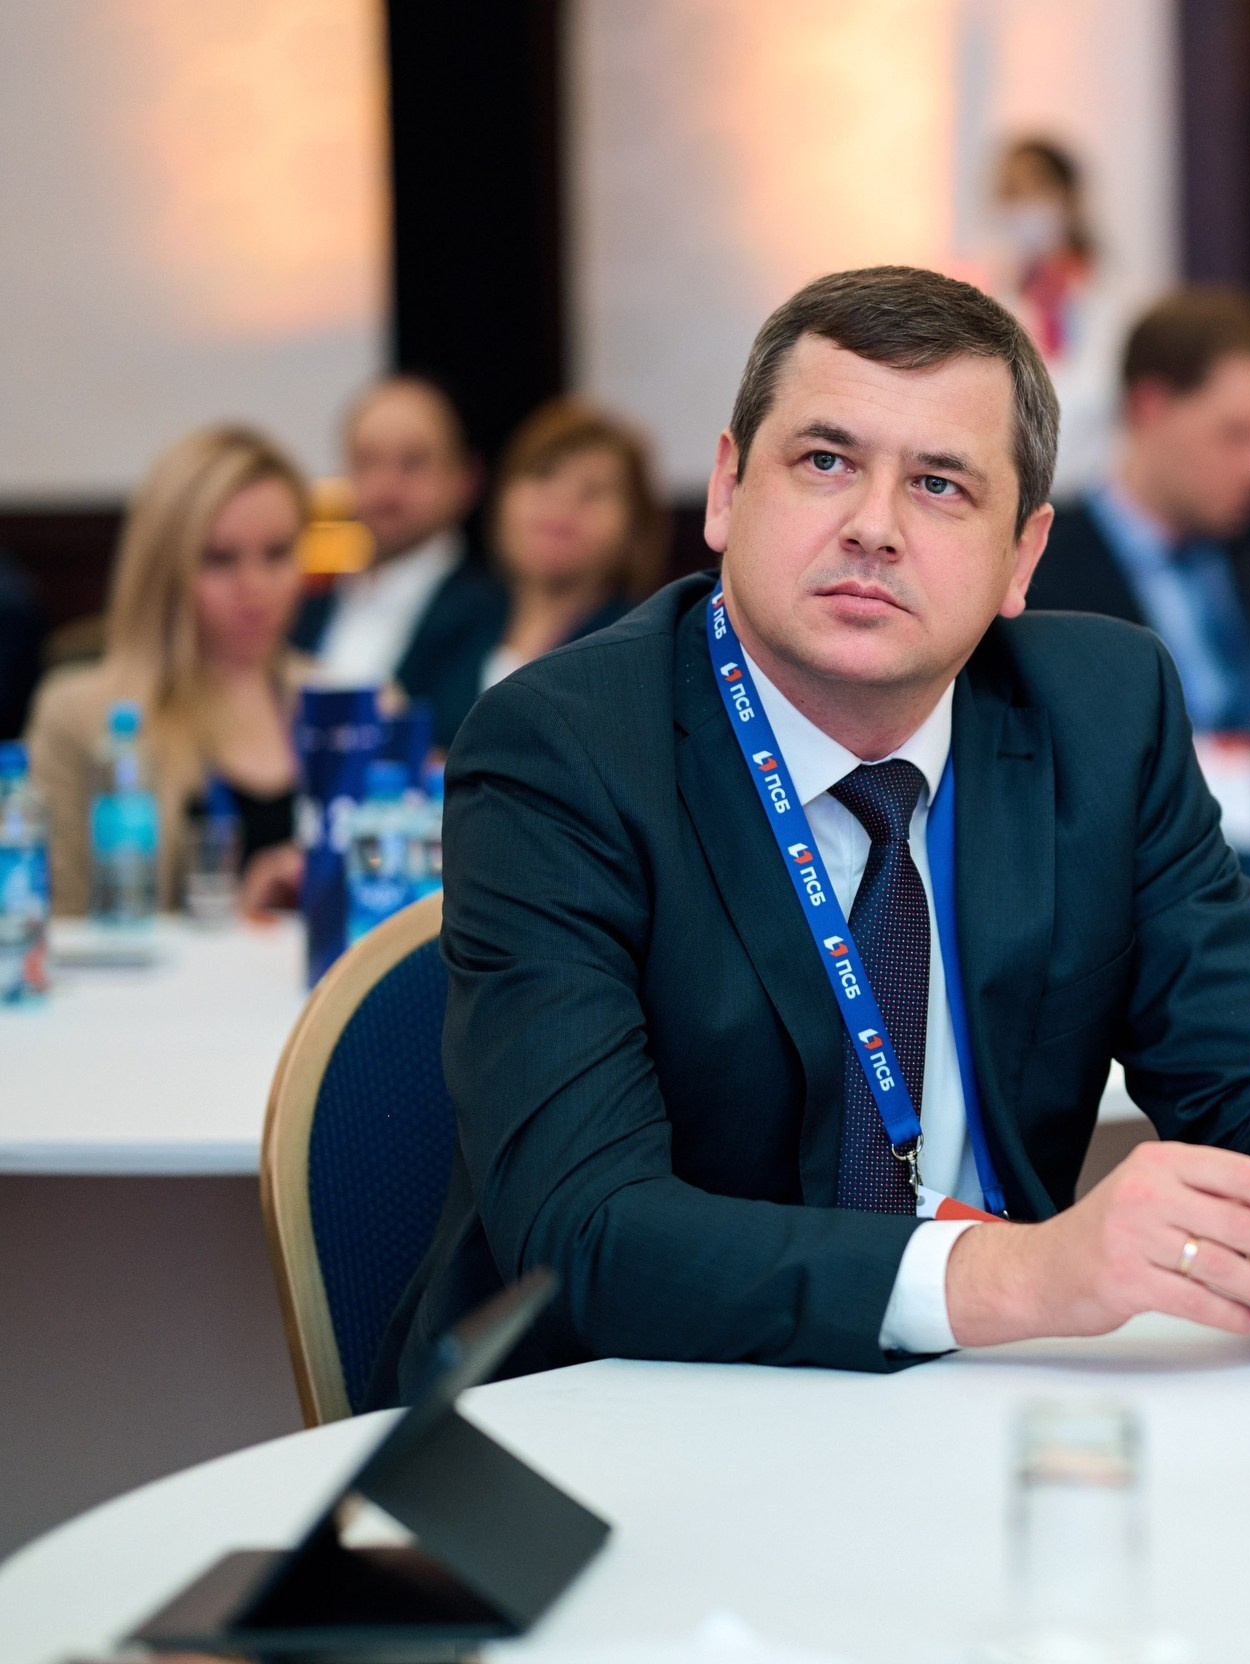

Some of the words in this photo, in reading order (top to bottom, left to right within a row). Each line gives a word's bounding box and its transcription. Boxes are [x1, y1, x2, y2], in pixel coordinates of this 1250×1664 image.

[713, 606, 728, 640] ПСБ
[729, 683, 755, 722] ПСБ
[764, 773, 791, 814] ПСБ
[800, 866, 826, 907] ПСБ
[835, 959, 861, 999] ПСБ
[870, 1051, 895, 1091] ПСБ
